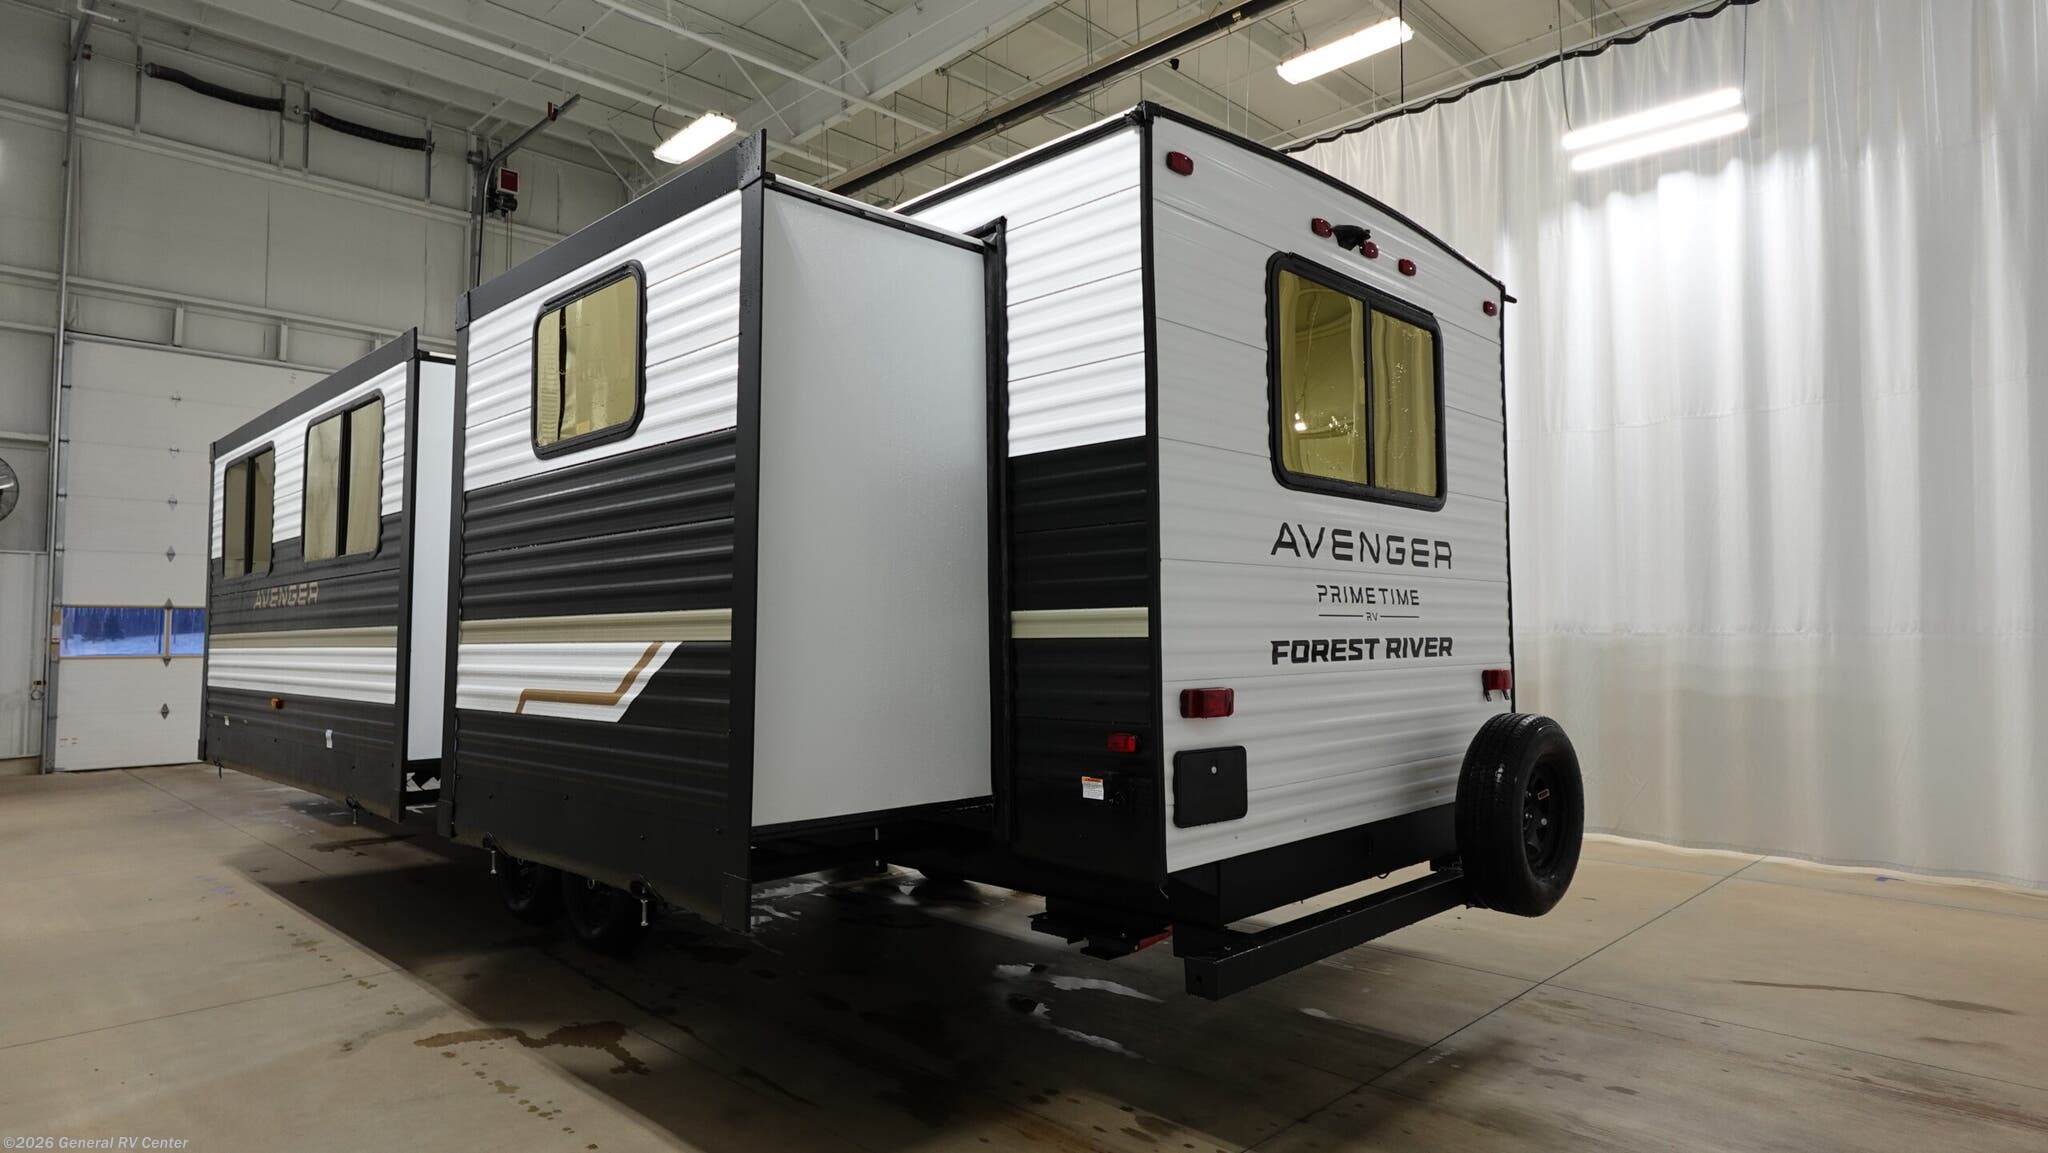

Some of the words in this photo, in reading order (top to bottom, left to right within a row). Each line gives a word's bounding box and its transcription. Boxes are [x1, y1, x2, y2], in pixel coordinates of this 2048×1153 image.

[1271, 522, 1452, 569] AVENGER
[254, 582, 320, 609] AVENGER
[1366, 612, 1378, 621] RV
[1271, 638, 1380, 665] FOREST
[1385, 637, 1453, 659] RIVER
